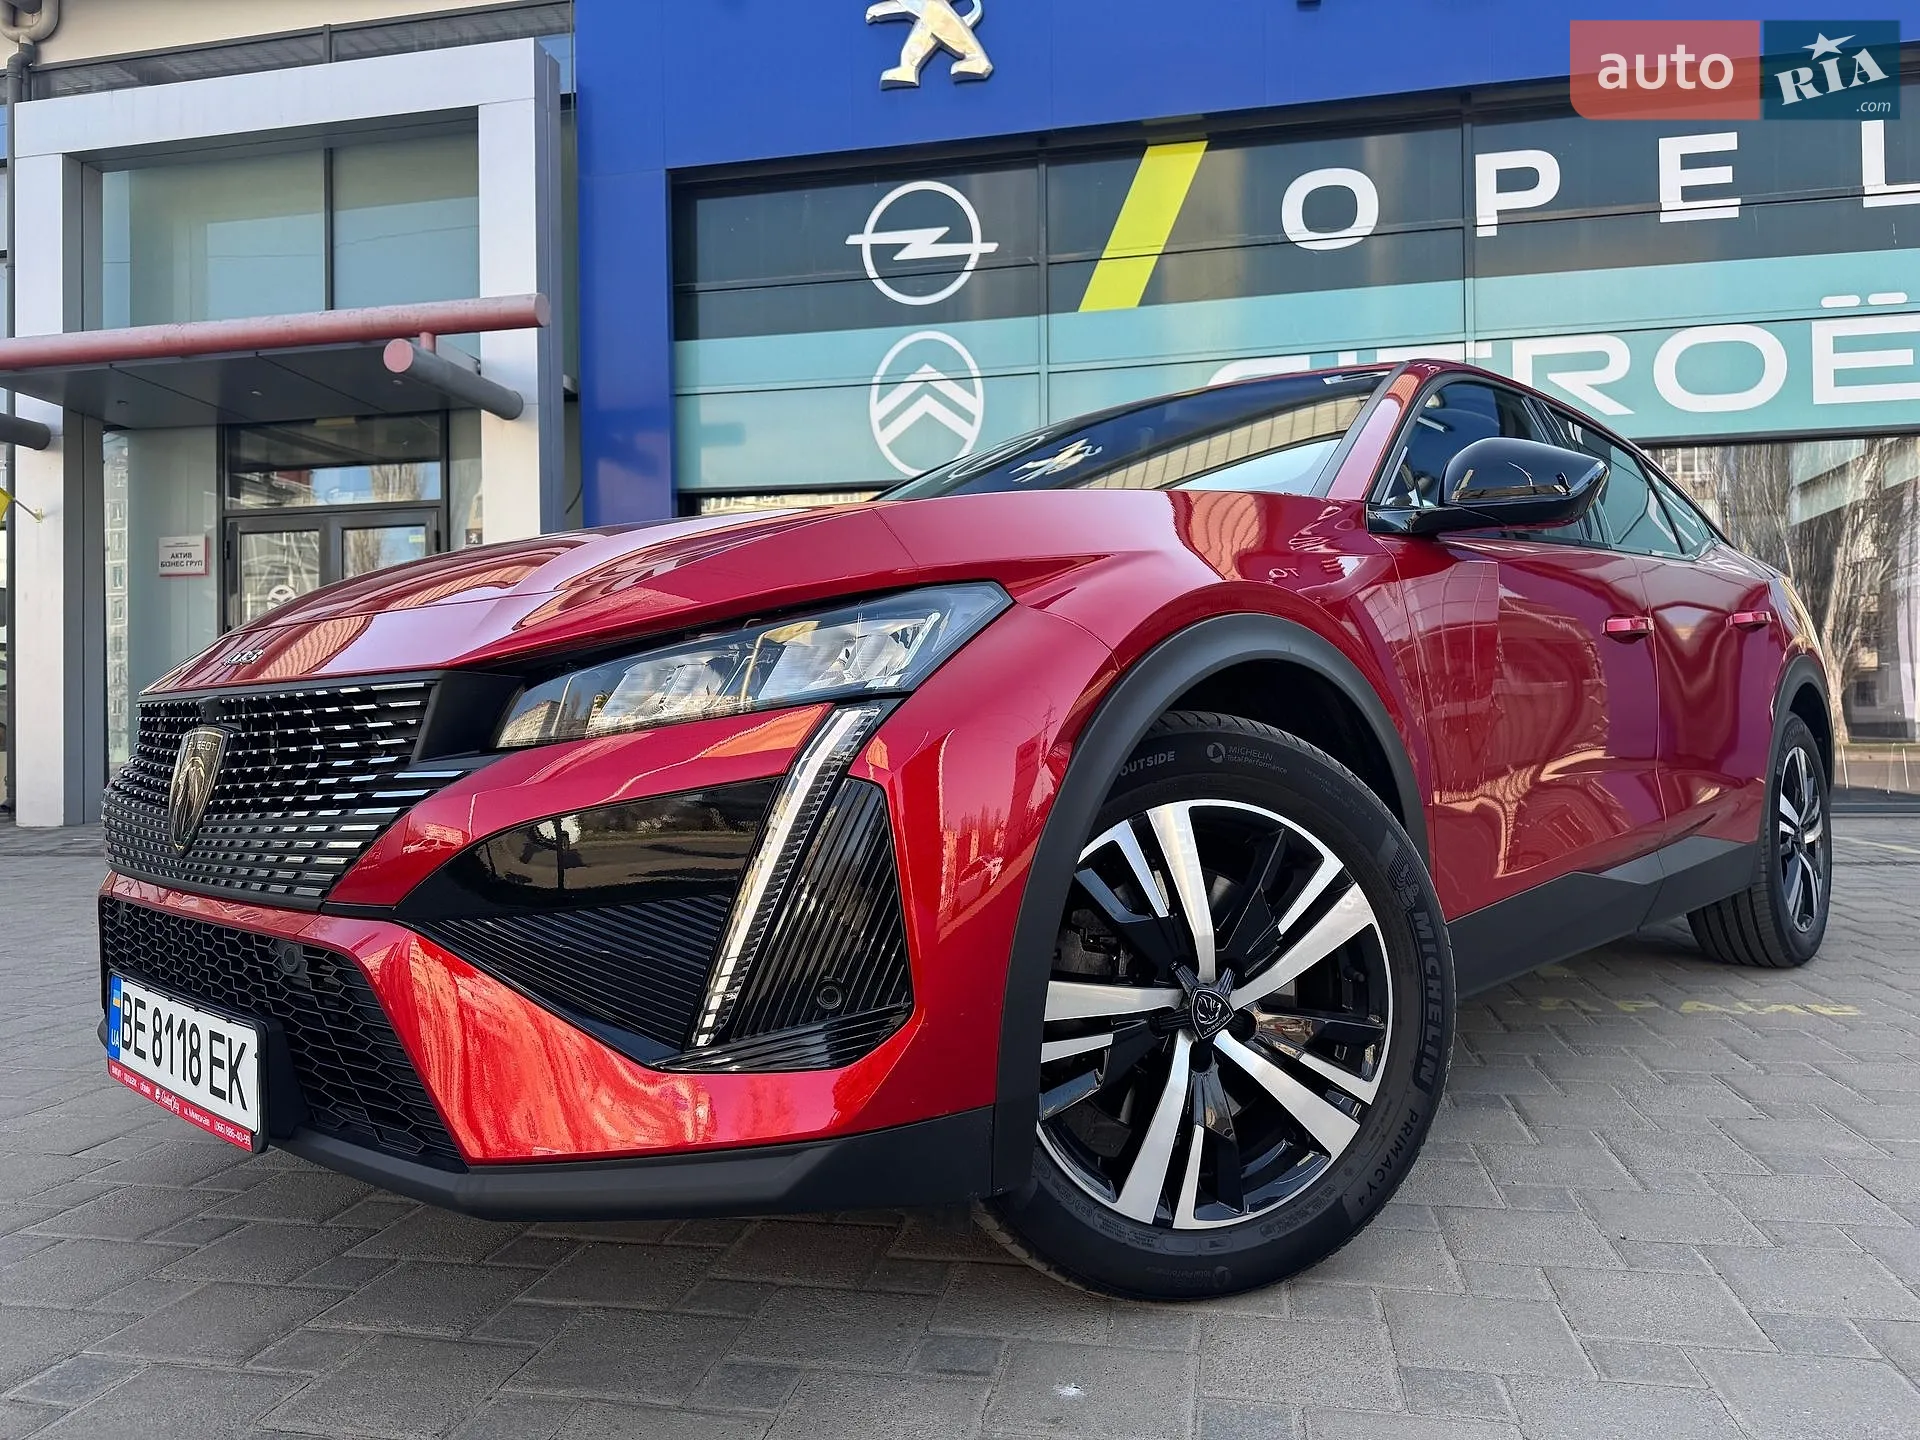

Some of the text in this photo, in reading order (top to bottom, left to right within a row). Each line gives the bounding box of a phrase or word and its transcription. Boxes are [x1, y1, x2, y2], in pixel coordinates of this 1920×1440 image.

[1281, 119, 1920, 250] OPEL
[170, 552, 193, 560] АКТИВ
[1120, 750, 1176, 777] OUTSIDE
[1229, 745, 1274, 762] MICHELIN
[1413, 910, 1444, 1086] MICHELIN
[111, 1028, 120, 1048] UA
[121, 991, 249, 1112] BE 8118 EK
[1366, 1107, 1419, 1197] PRIMACY
